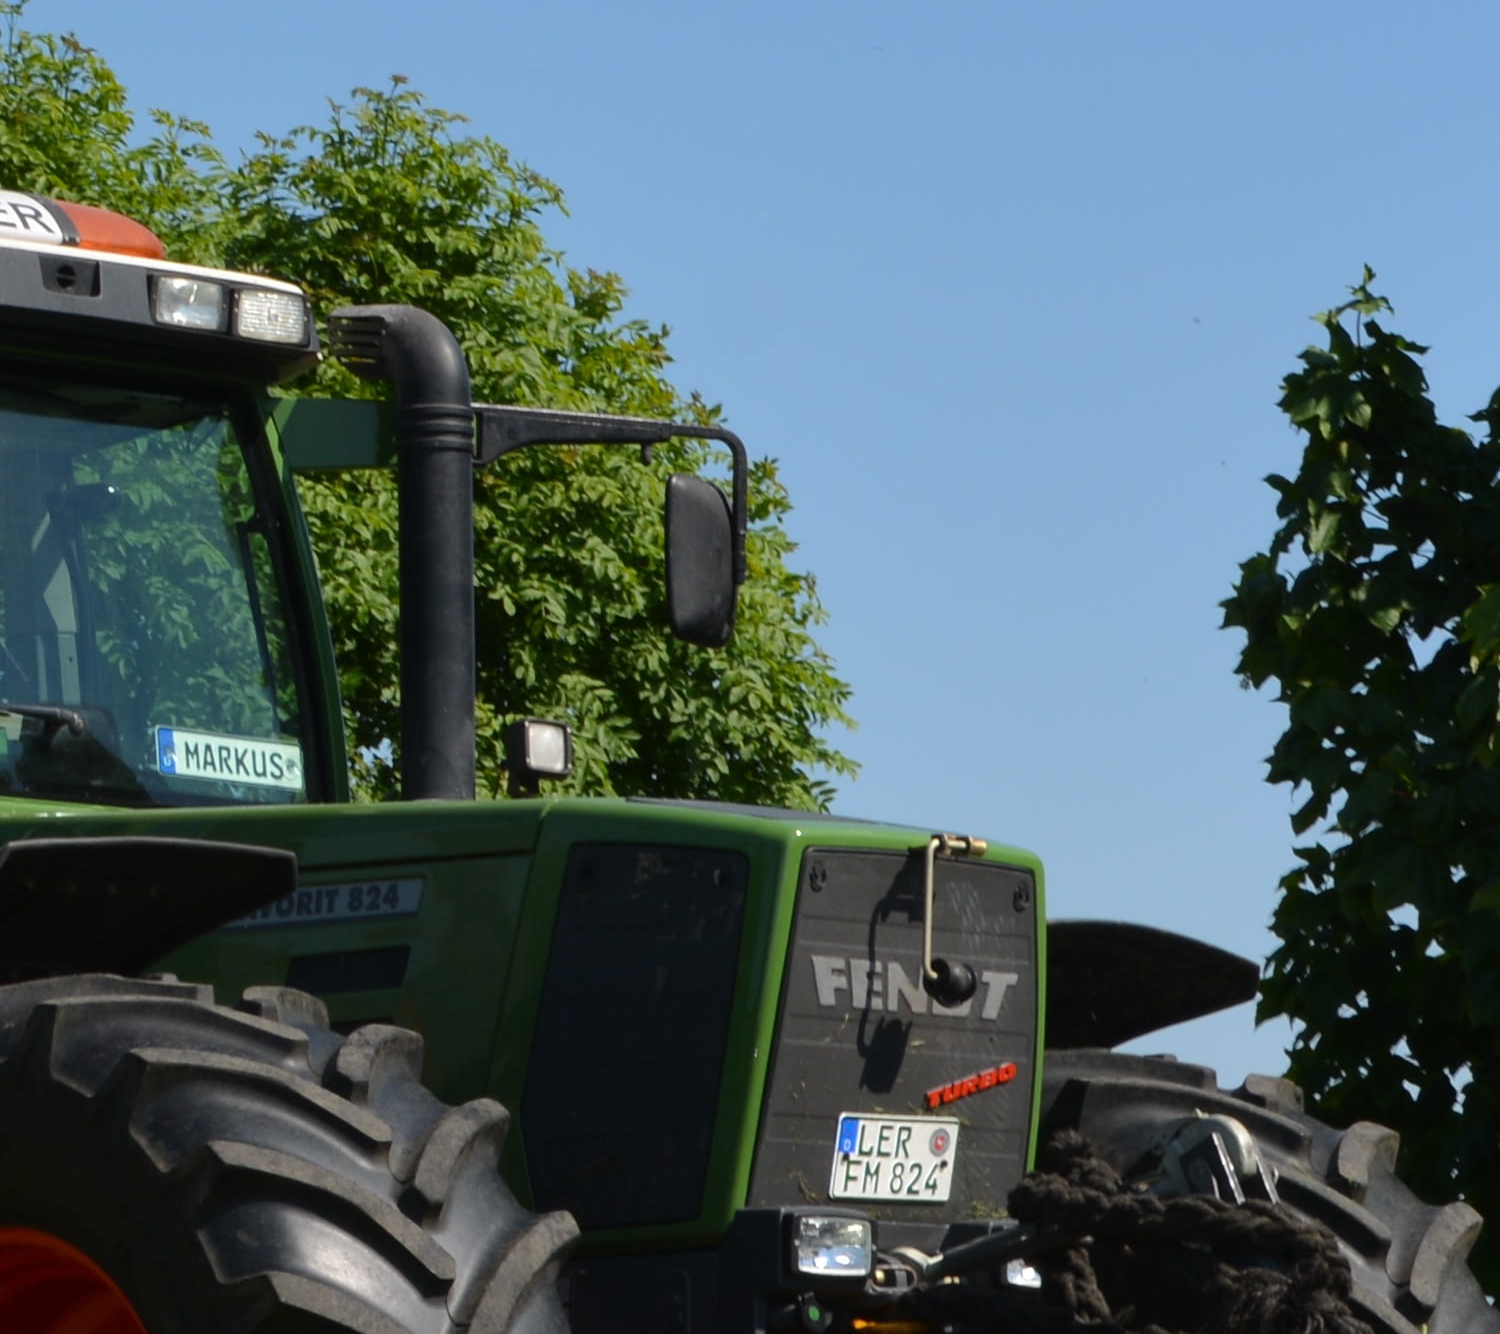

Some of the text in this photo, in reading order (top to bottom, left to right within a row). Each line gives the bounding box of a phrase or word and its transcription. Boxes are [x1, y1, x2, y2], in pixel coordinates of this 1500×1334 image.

[184, 740, 284, 780] MARKUS
[347, 883, 399, 911] 824
[811, 955, 1016, 1020] FENT
[925, 1062, 1017, 1109] TURBO
[858, 1124, 913, 1158] LER
[843, 1160, 939, 1196] FM 824
